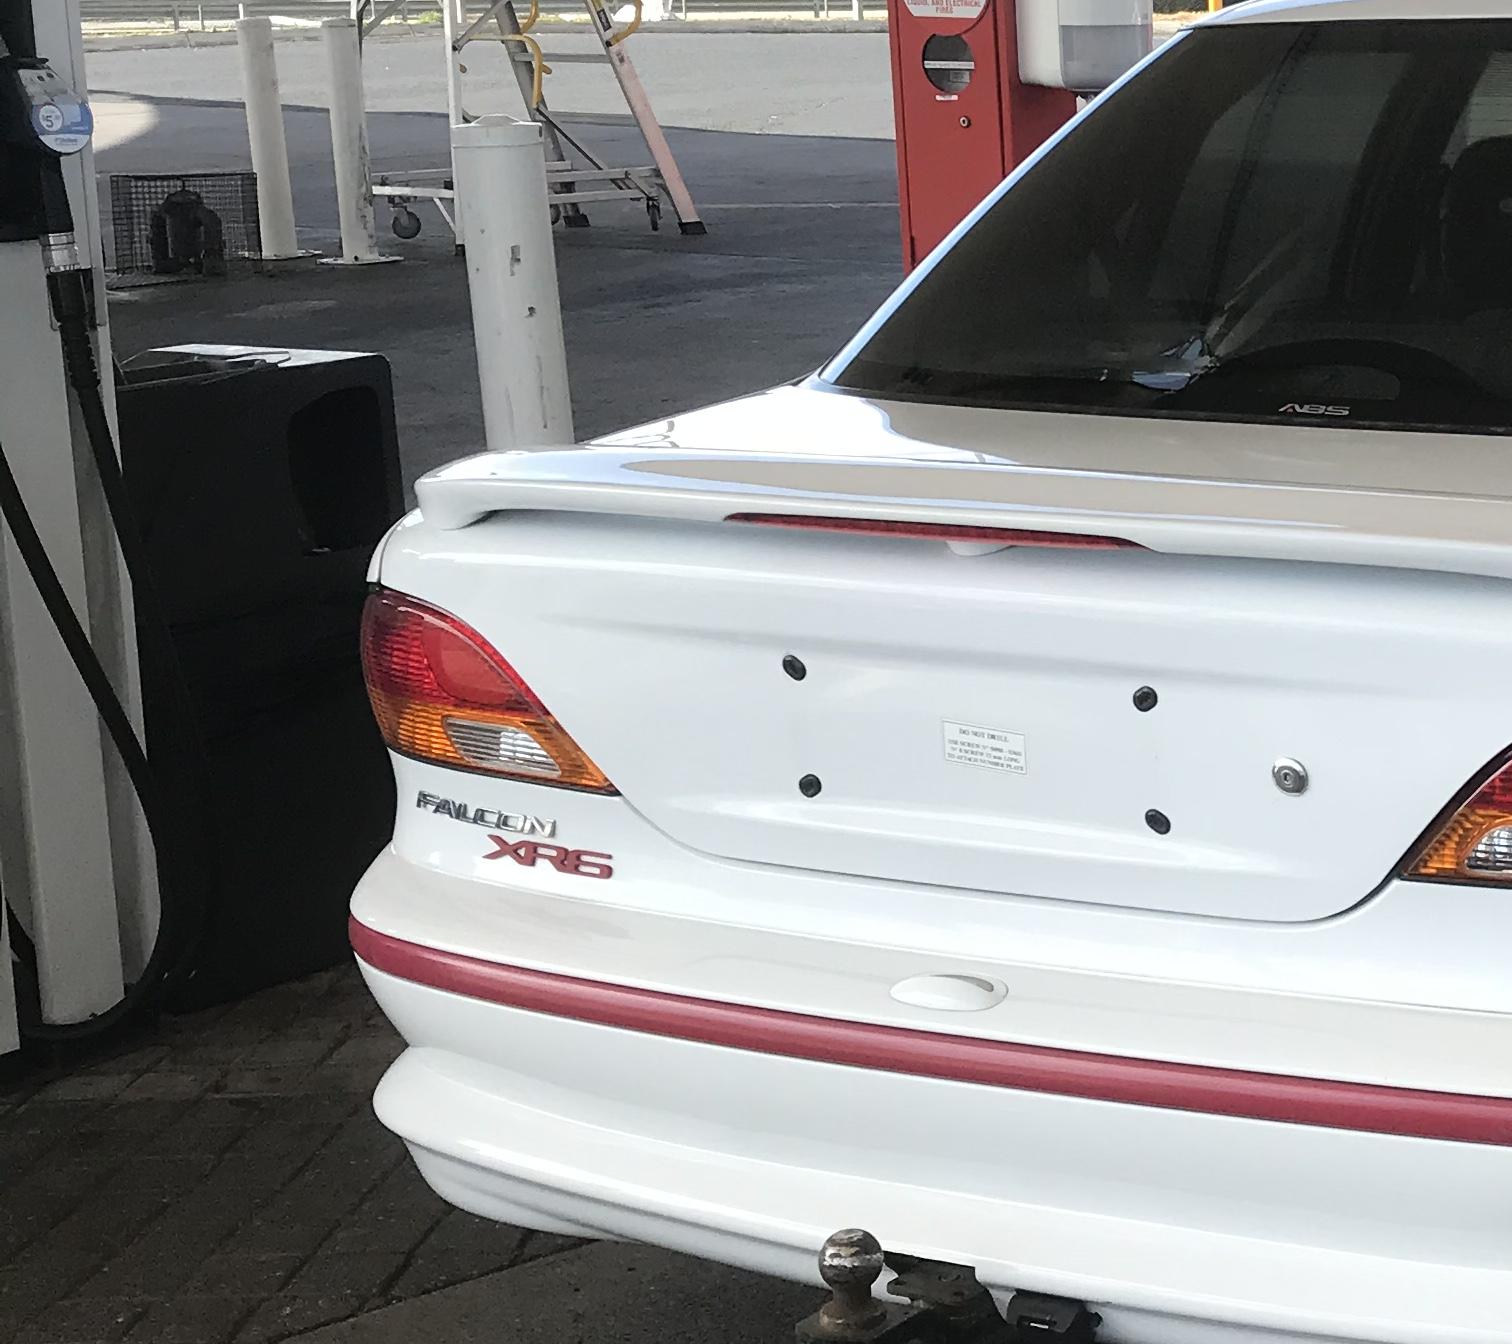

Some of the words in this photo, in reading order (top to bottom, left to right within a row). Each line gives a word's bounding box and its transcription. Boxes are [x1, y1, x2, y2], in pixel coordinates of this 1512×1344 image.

[1278, 403, 1351, 416] ABS
[970, 730, 986, 739] NOT
[986, 732, 1009, 743] DRILL
[416, 790, 557, 839] FALCON
[481, 833, 614, 880] XR6
